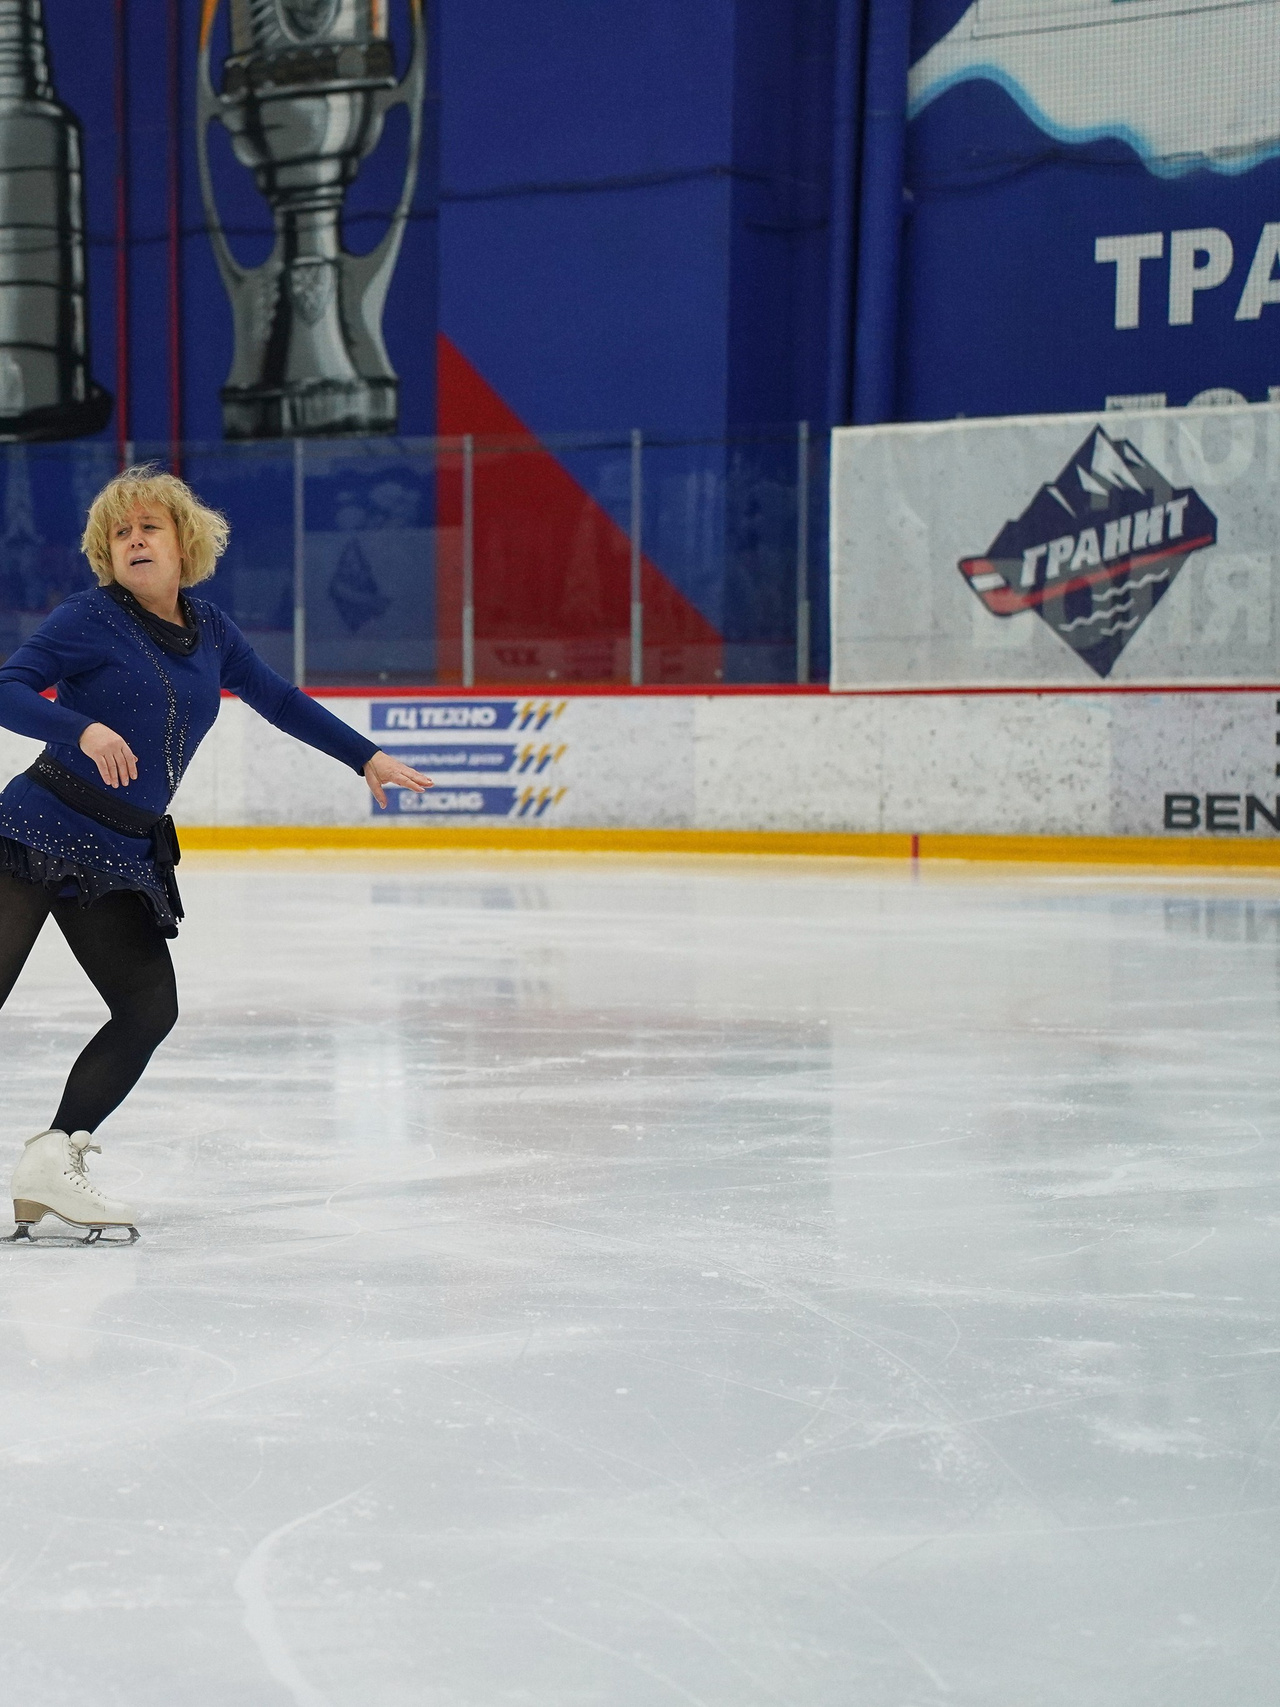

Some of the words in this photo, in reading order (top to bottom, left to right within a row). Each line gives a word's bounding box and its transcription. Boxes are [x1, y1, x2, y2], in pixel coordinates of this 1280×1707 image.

[1020, 495, 1189, 588] ГРАНИТ
[385, 707, 417, 729] ГЦ
[420, 706, 497, 727] ТЕХНО
